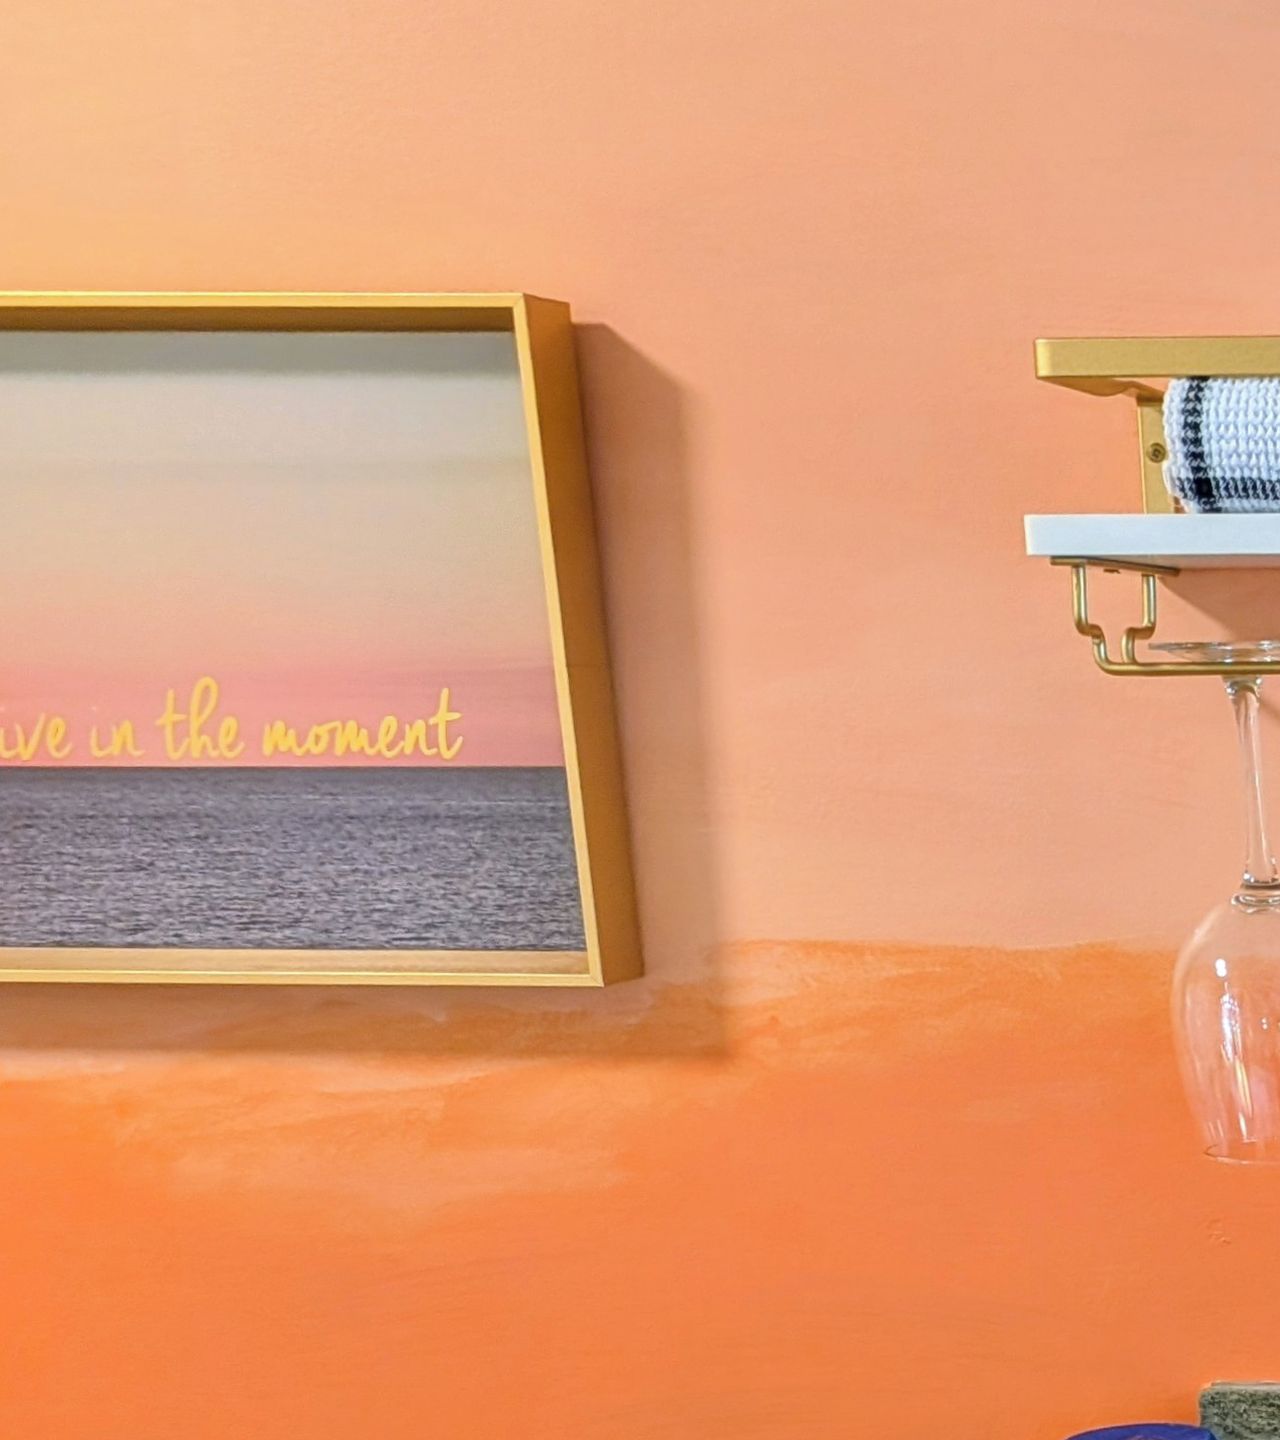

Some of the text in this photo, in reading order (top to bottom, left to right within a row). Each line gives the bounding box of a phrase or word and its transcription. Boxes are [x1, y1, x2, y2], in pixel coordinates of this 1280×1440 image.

[89, 705, 145, 757] in
[155, 676, 244, 760] the
[263, 688, 464, 760] moment
